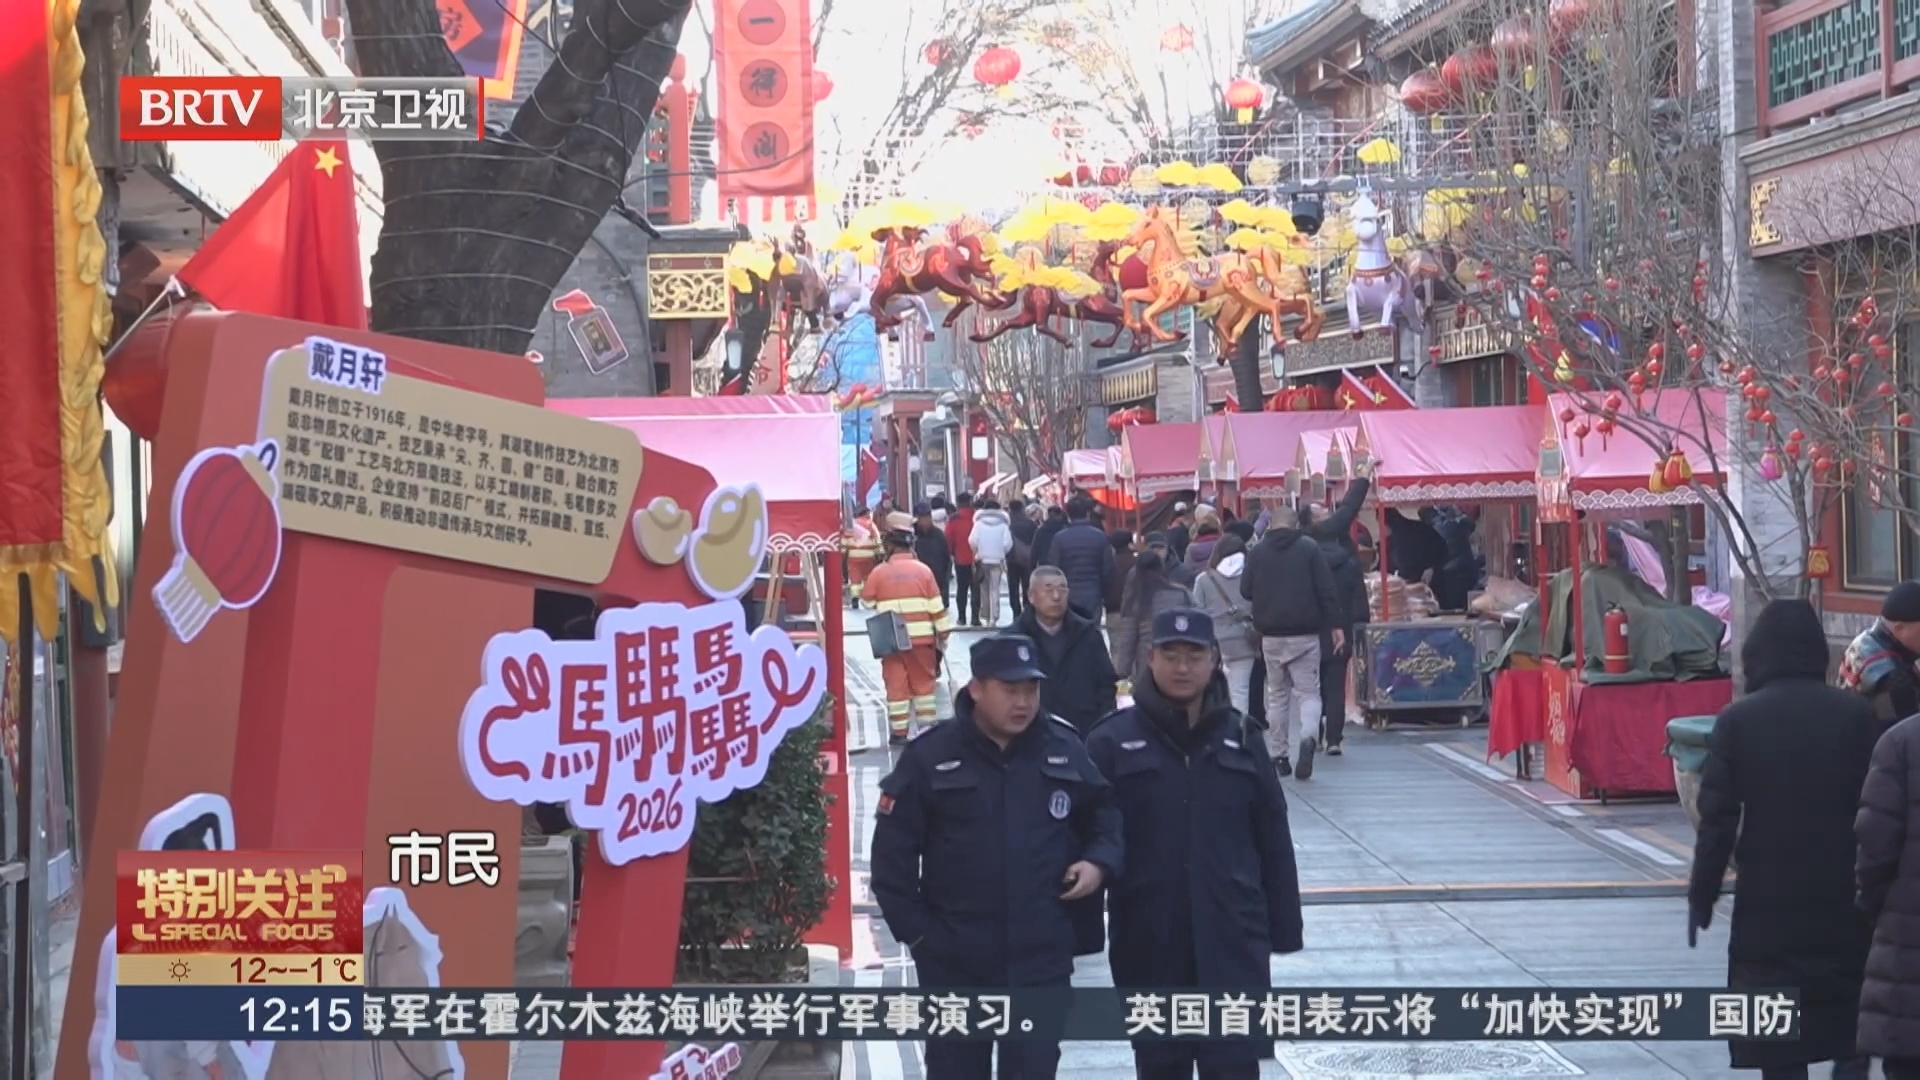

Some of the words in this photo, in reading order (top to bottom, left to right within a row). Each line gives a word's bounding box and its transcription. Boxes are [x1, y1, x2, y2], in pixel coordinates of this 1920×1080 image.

[311, 342, 385, 390] 戴月轩
[616, 778, 684, 843] 2026
